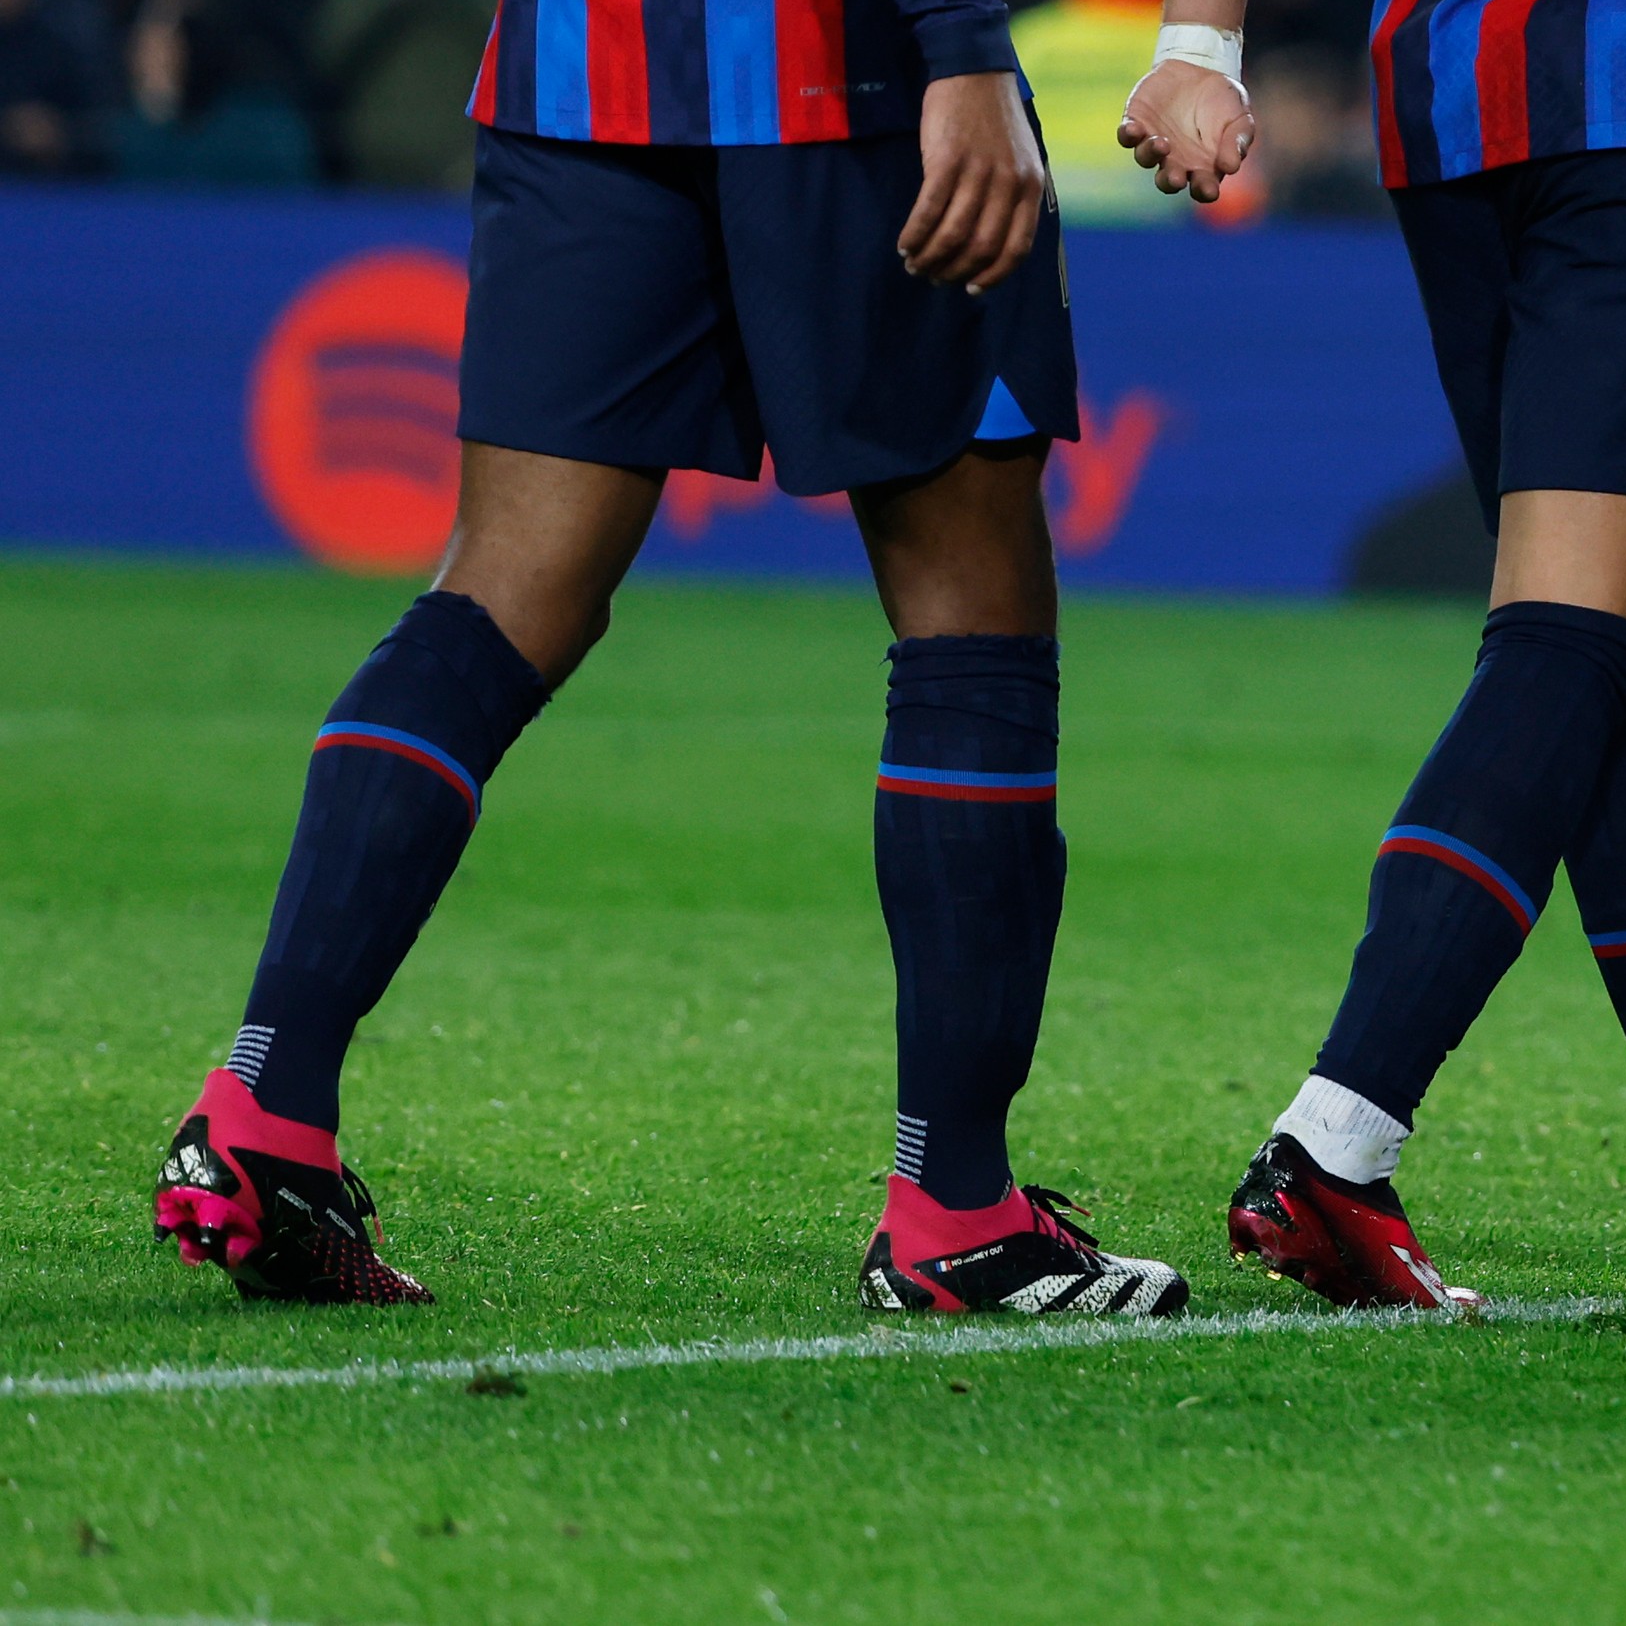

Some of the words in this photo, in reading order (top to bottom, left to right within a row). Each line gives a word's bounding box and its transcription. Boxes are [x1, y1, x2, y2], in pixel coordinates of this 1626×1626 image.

[951, 1259, 963, 1267] NO
[963, 1249, 989, 1264] MONEY
[989, 1244, 1004, 1256] OUT
